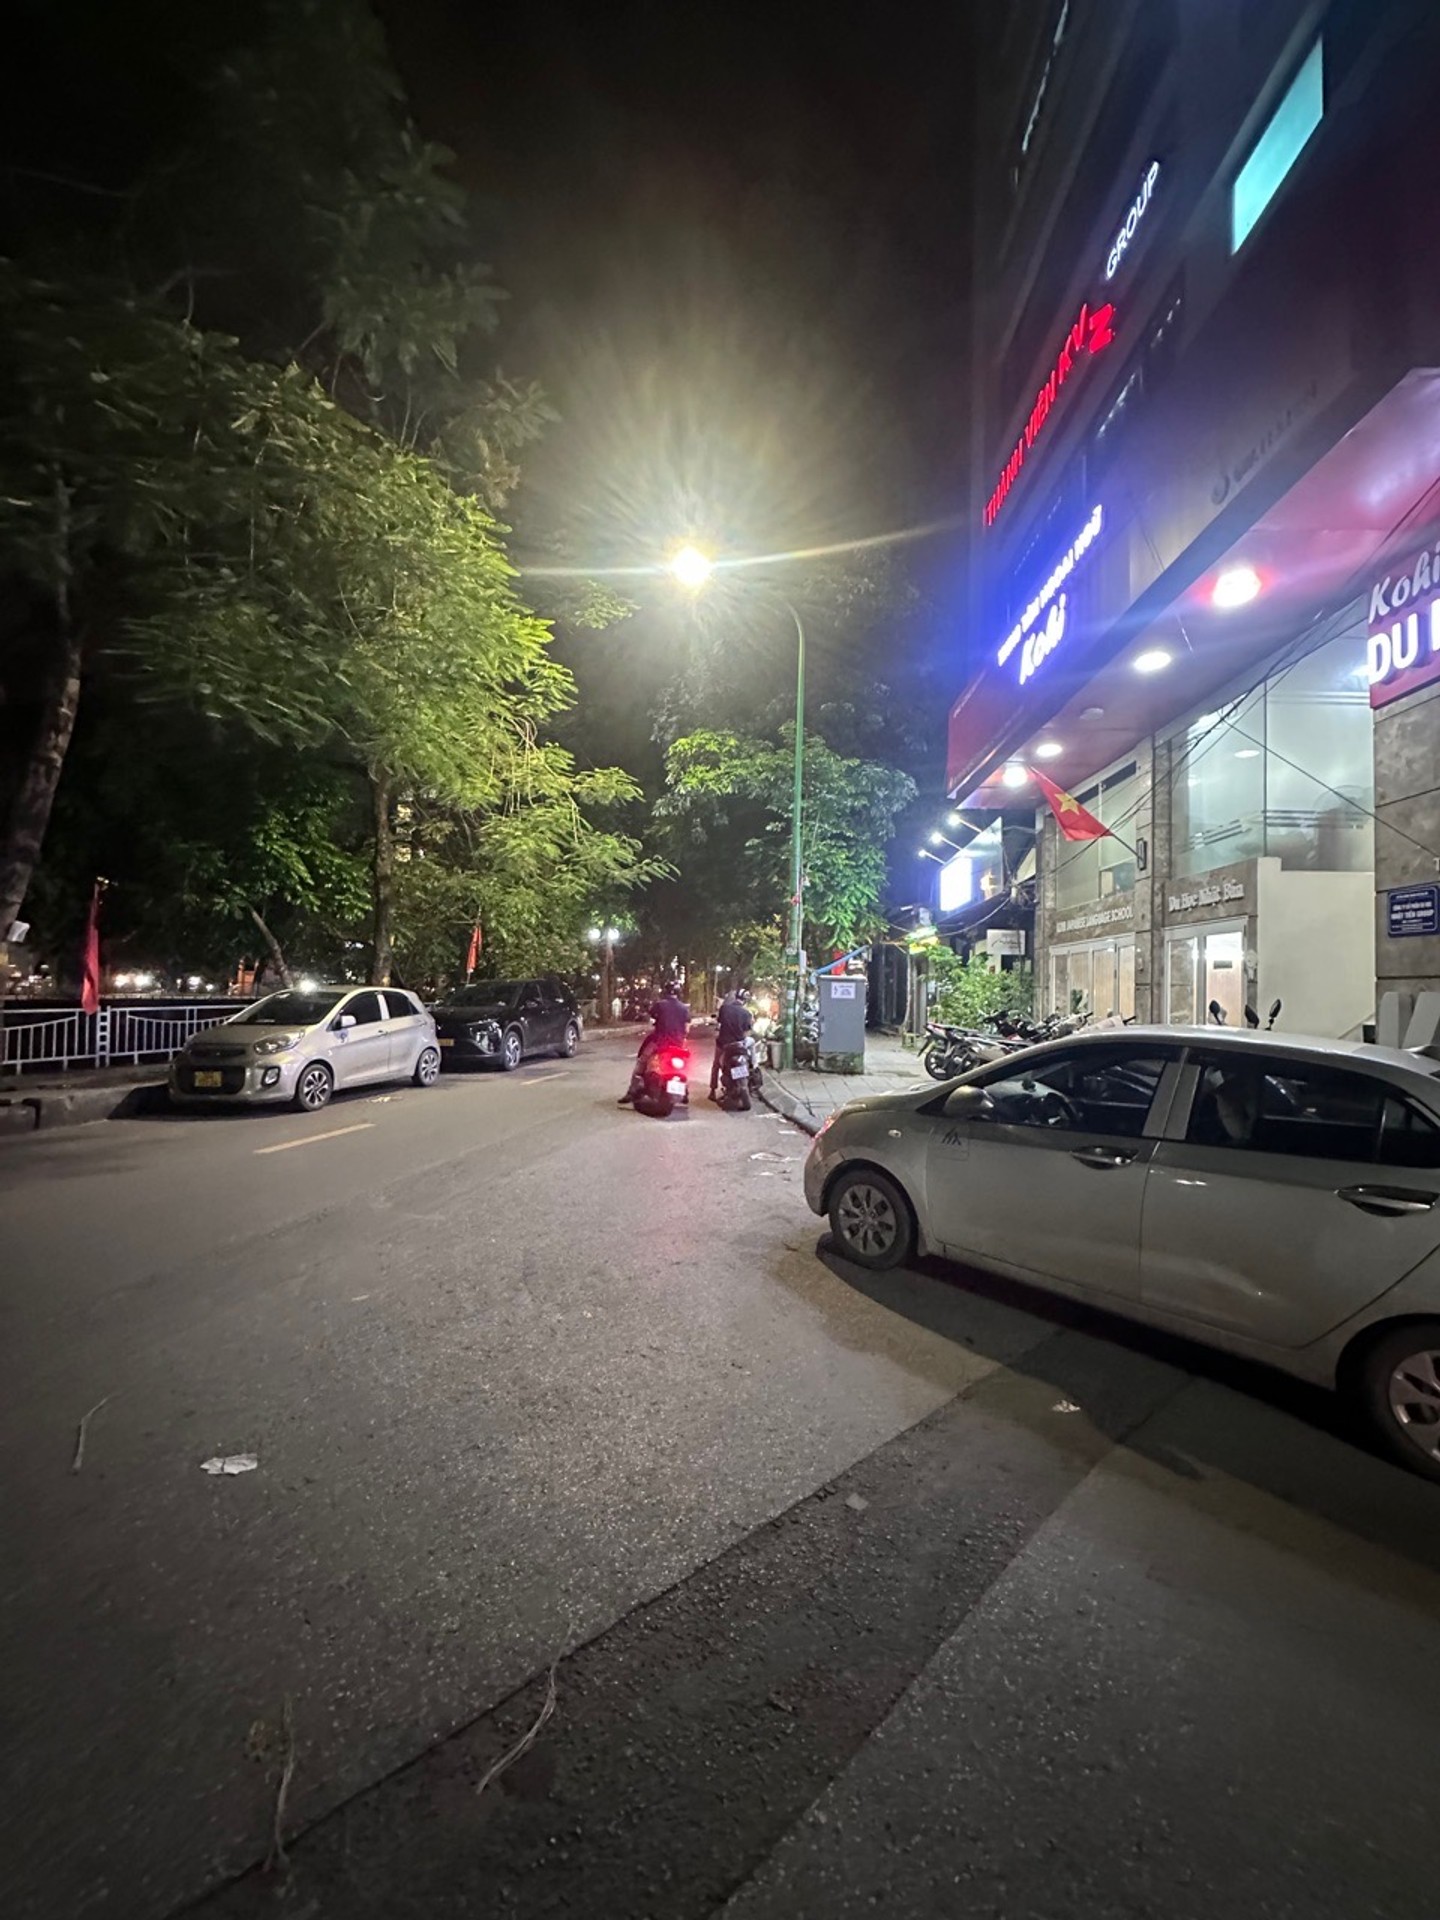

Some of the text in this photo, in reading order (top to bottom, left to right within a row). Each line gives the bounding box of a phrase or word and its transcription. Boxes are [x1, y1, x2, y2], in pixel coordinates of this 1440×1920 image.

[1106, 161, 1159, 279] GROUP
[1367, 613, 1419, 685] DU
[1111, 905, 1134, 923] SCHOOL
